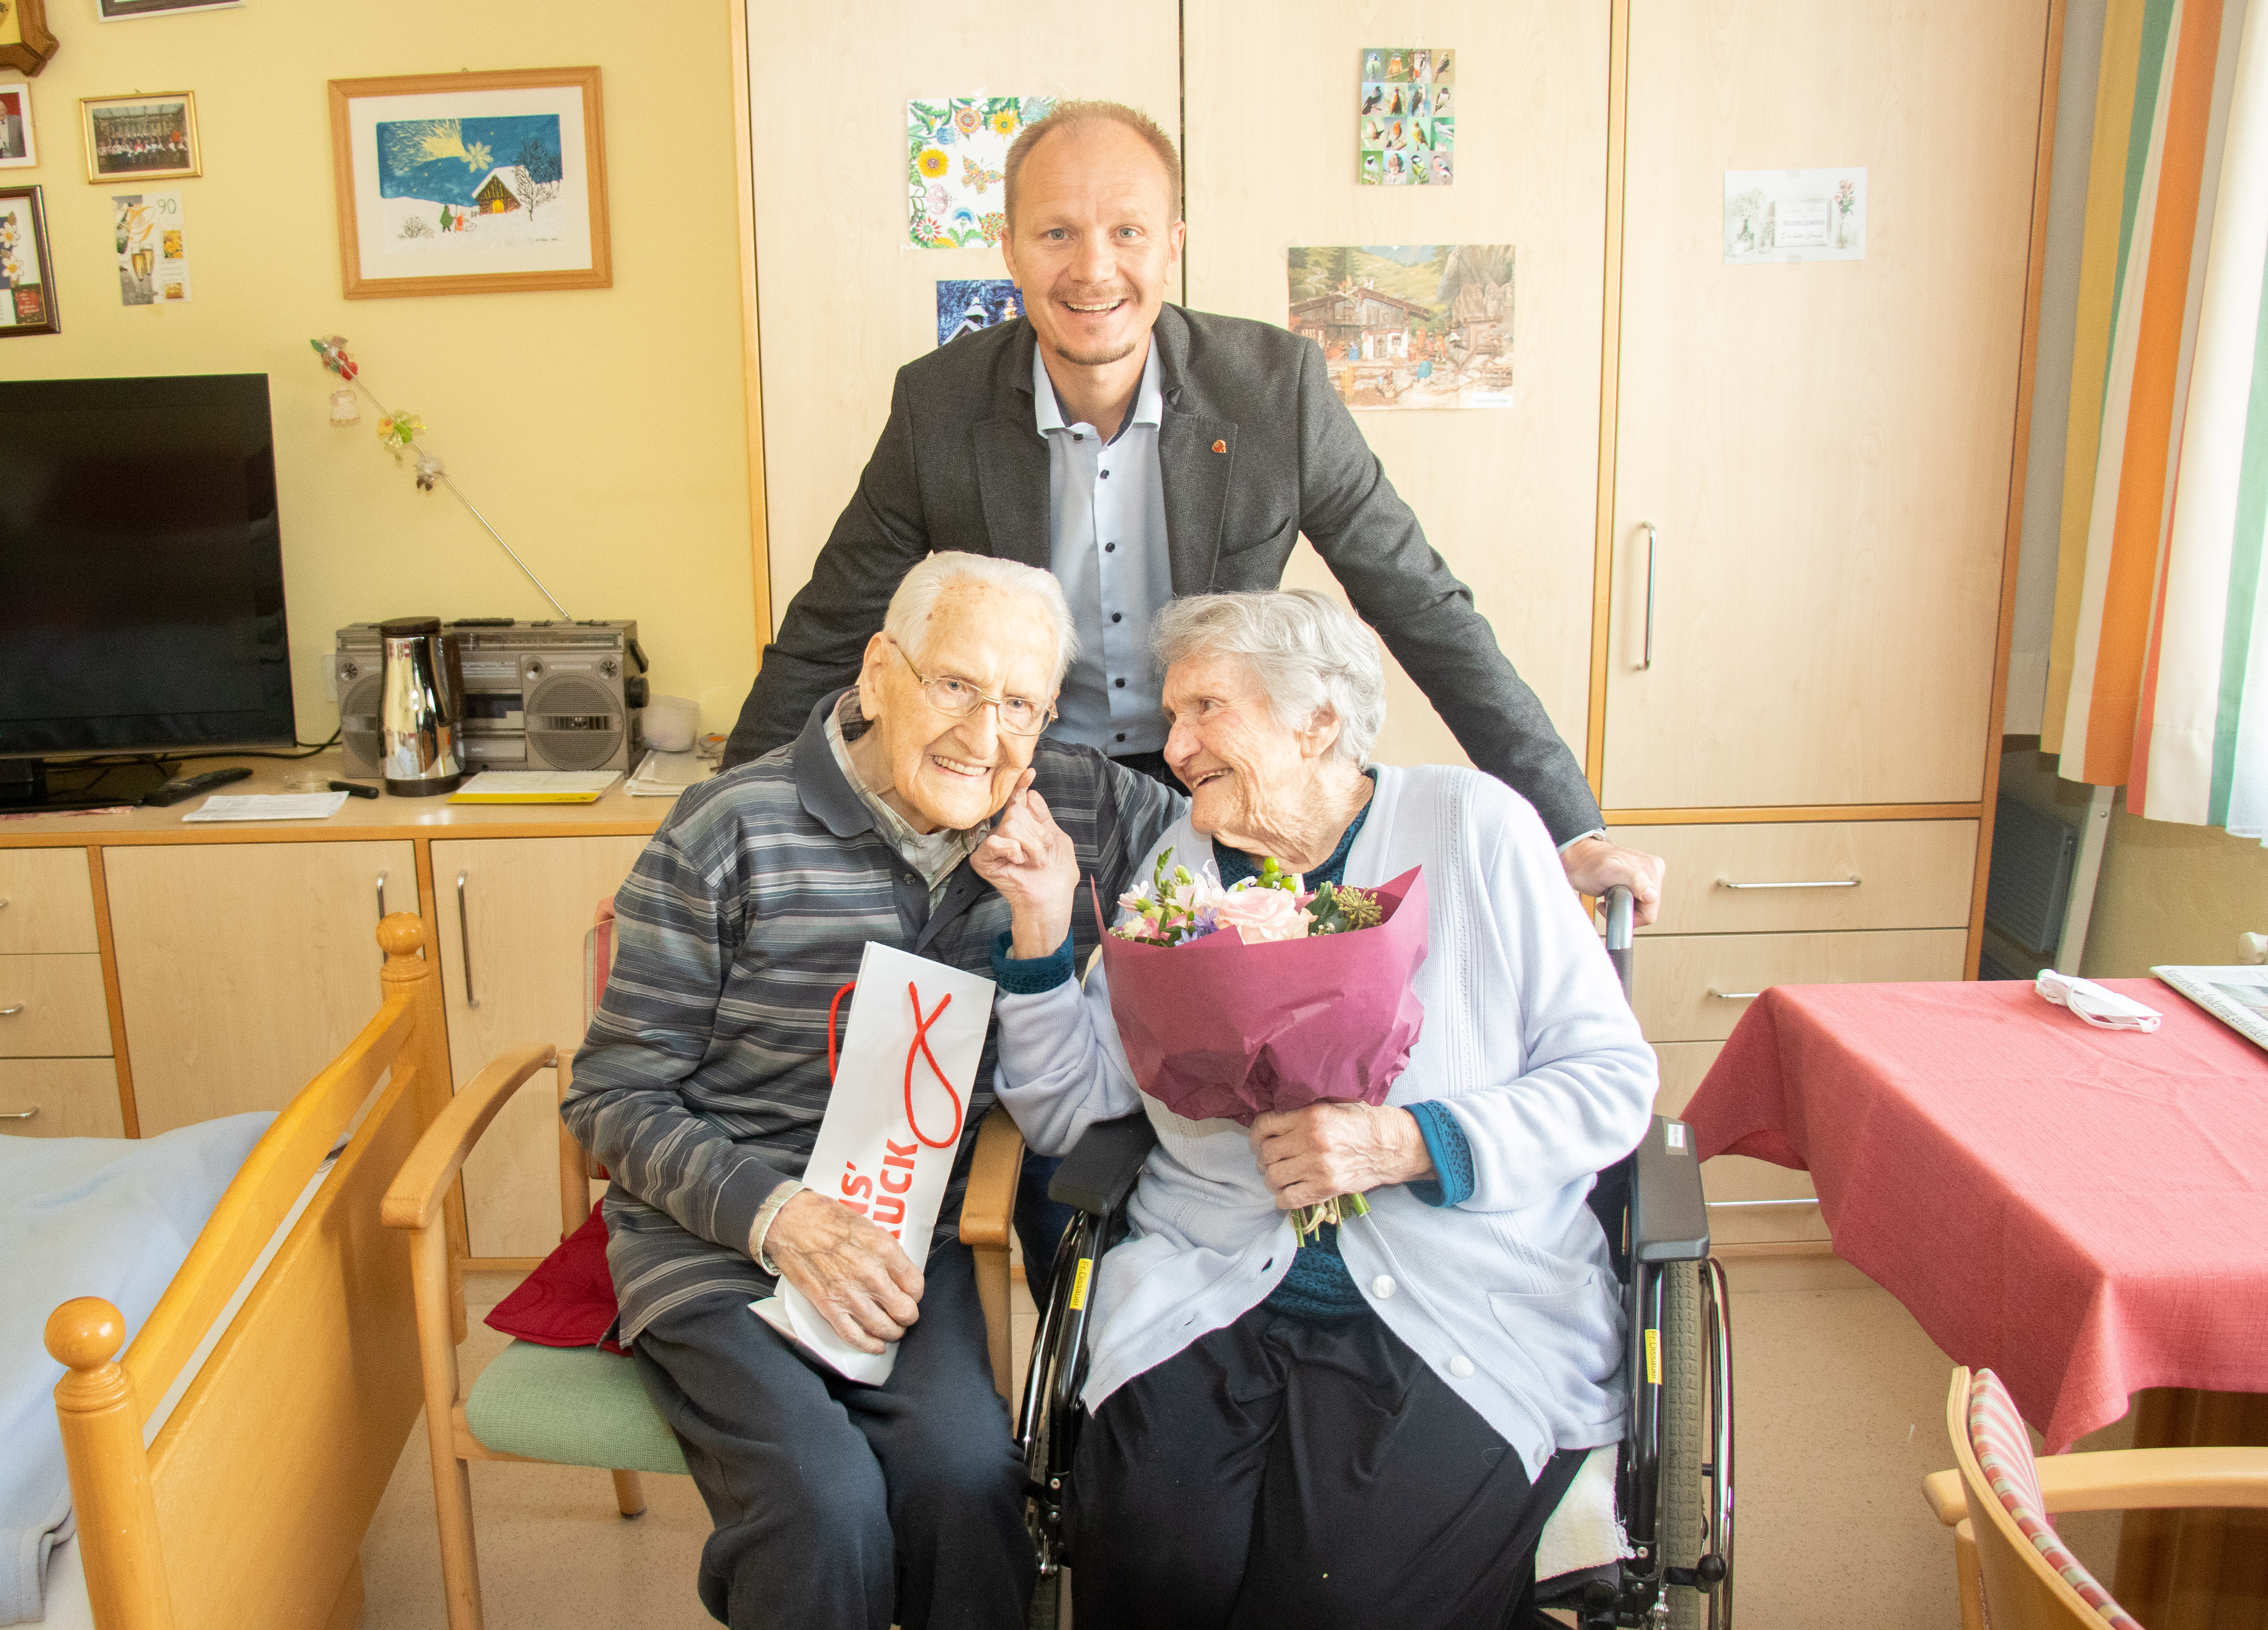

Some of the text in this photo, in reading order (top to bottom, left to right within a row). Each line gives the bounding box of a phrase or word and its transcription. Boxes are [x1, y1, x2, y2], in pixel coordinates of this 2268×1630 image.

[157, 198, 177, 214] 90
[2162, 969, 2204, 994] Kurzarbeit:
[872, 1138, 918, 1239] UCK
